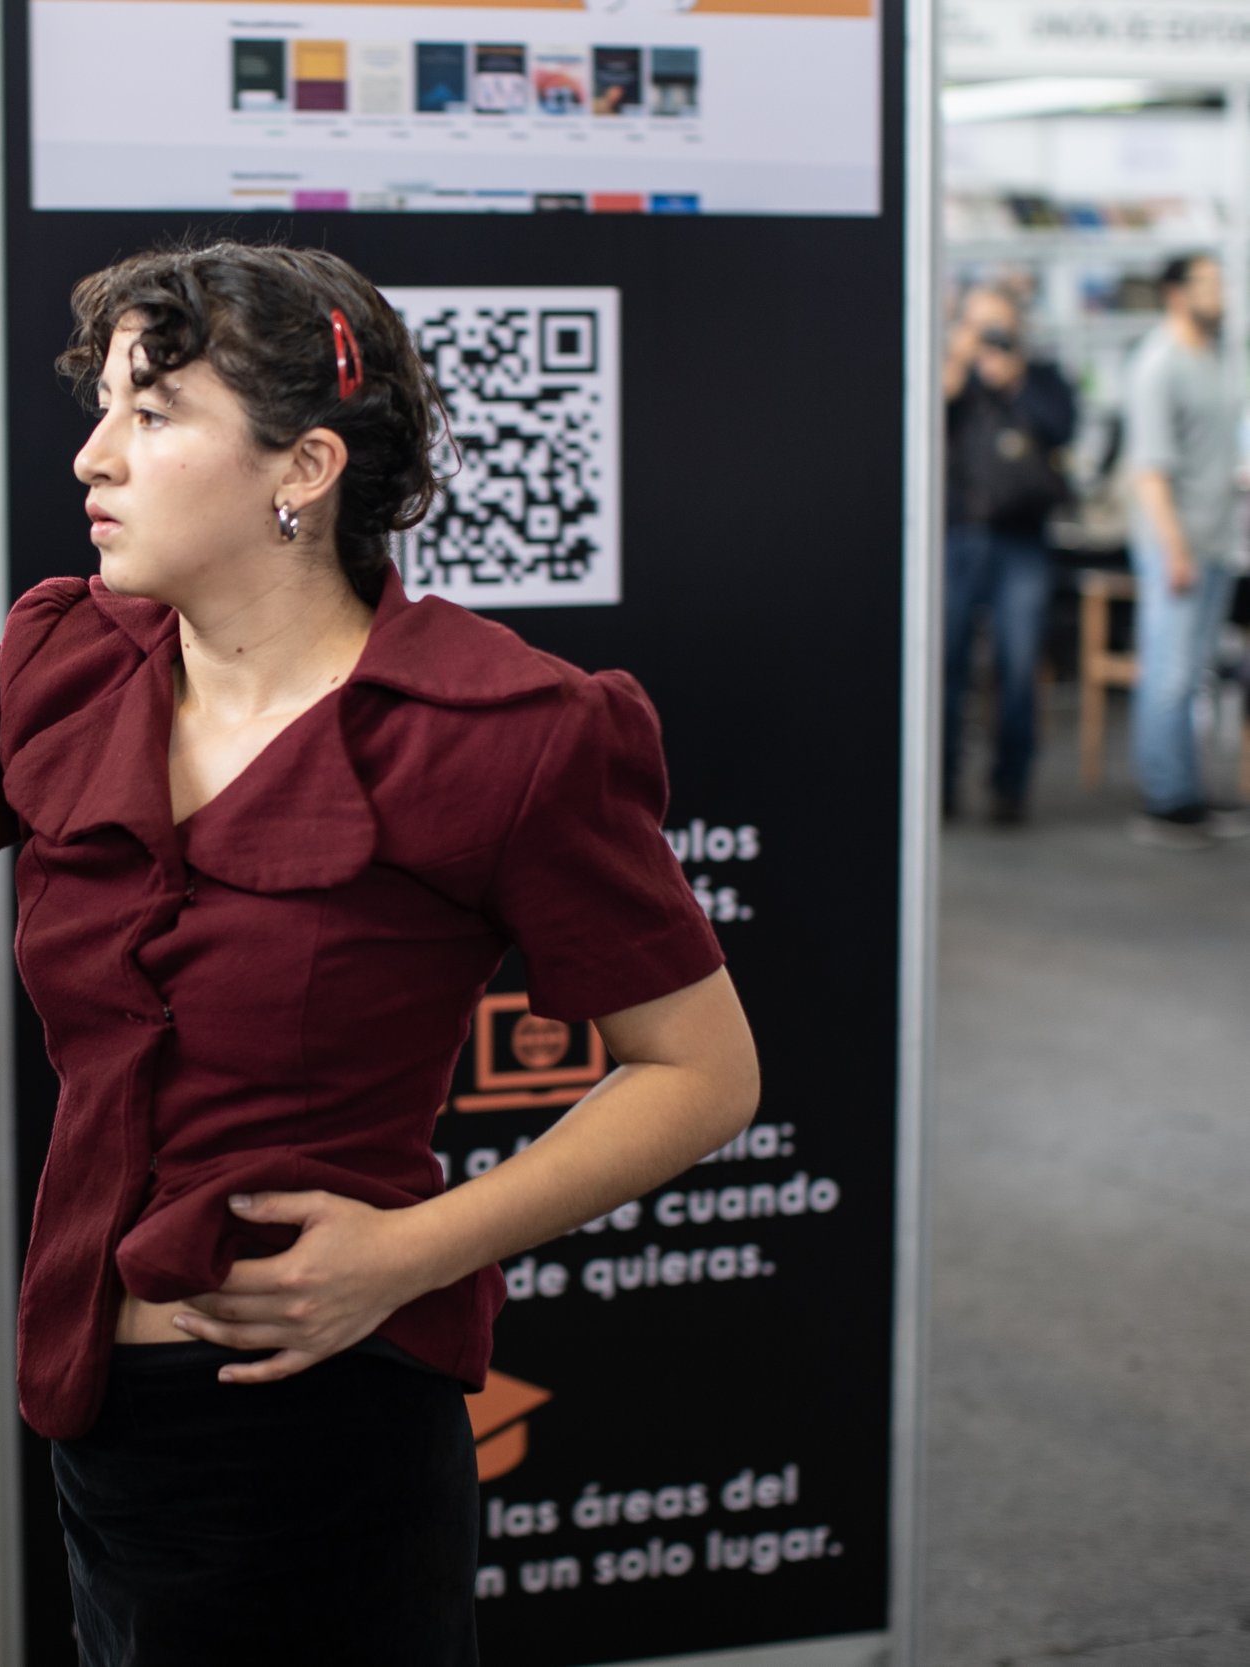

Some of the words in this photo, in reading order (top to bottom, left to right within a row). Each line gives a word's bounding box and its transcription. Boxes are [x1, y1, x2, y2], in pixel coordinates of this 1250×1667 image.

[661, 818, 760, 863] ulos
[655, 1171, 840, 1227] cuando
[506, 1257, 568, 1300] de
[582, 1243, 775, 1299] quieras.
[488, 1498, 558, 1538] las
[573, 1482, 708, 1529] áreas
[721, 1463, 799, 1512] del
[476, 1565, 505, 1598] n
[521, 1556, 580, 1593] un
[595, 1538, 693, 1584] solo
[707, 1525, 844, 1575] lugar.
